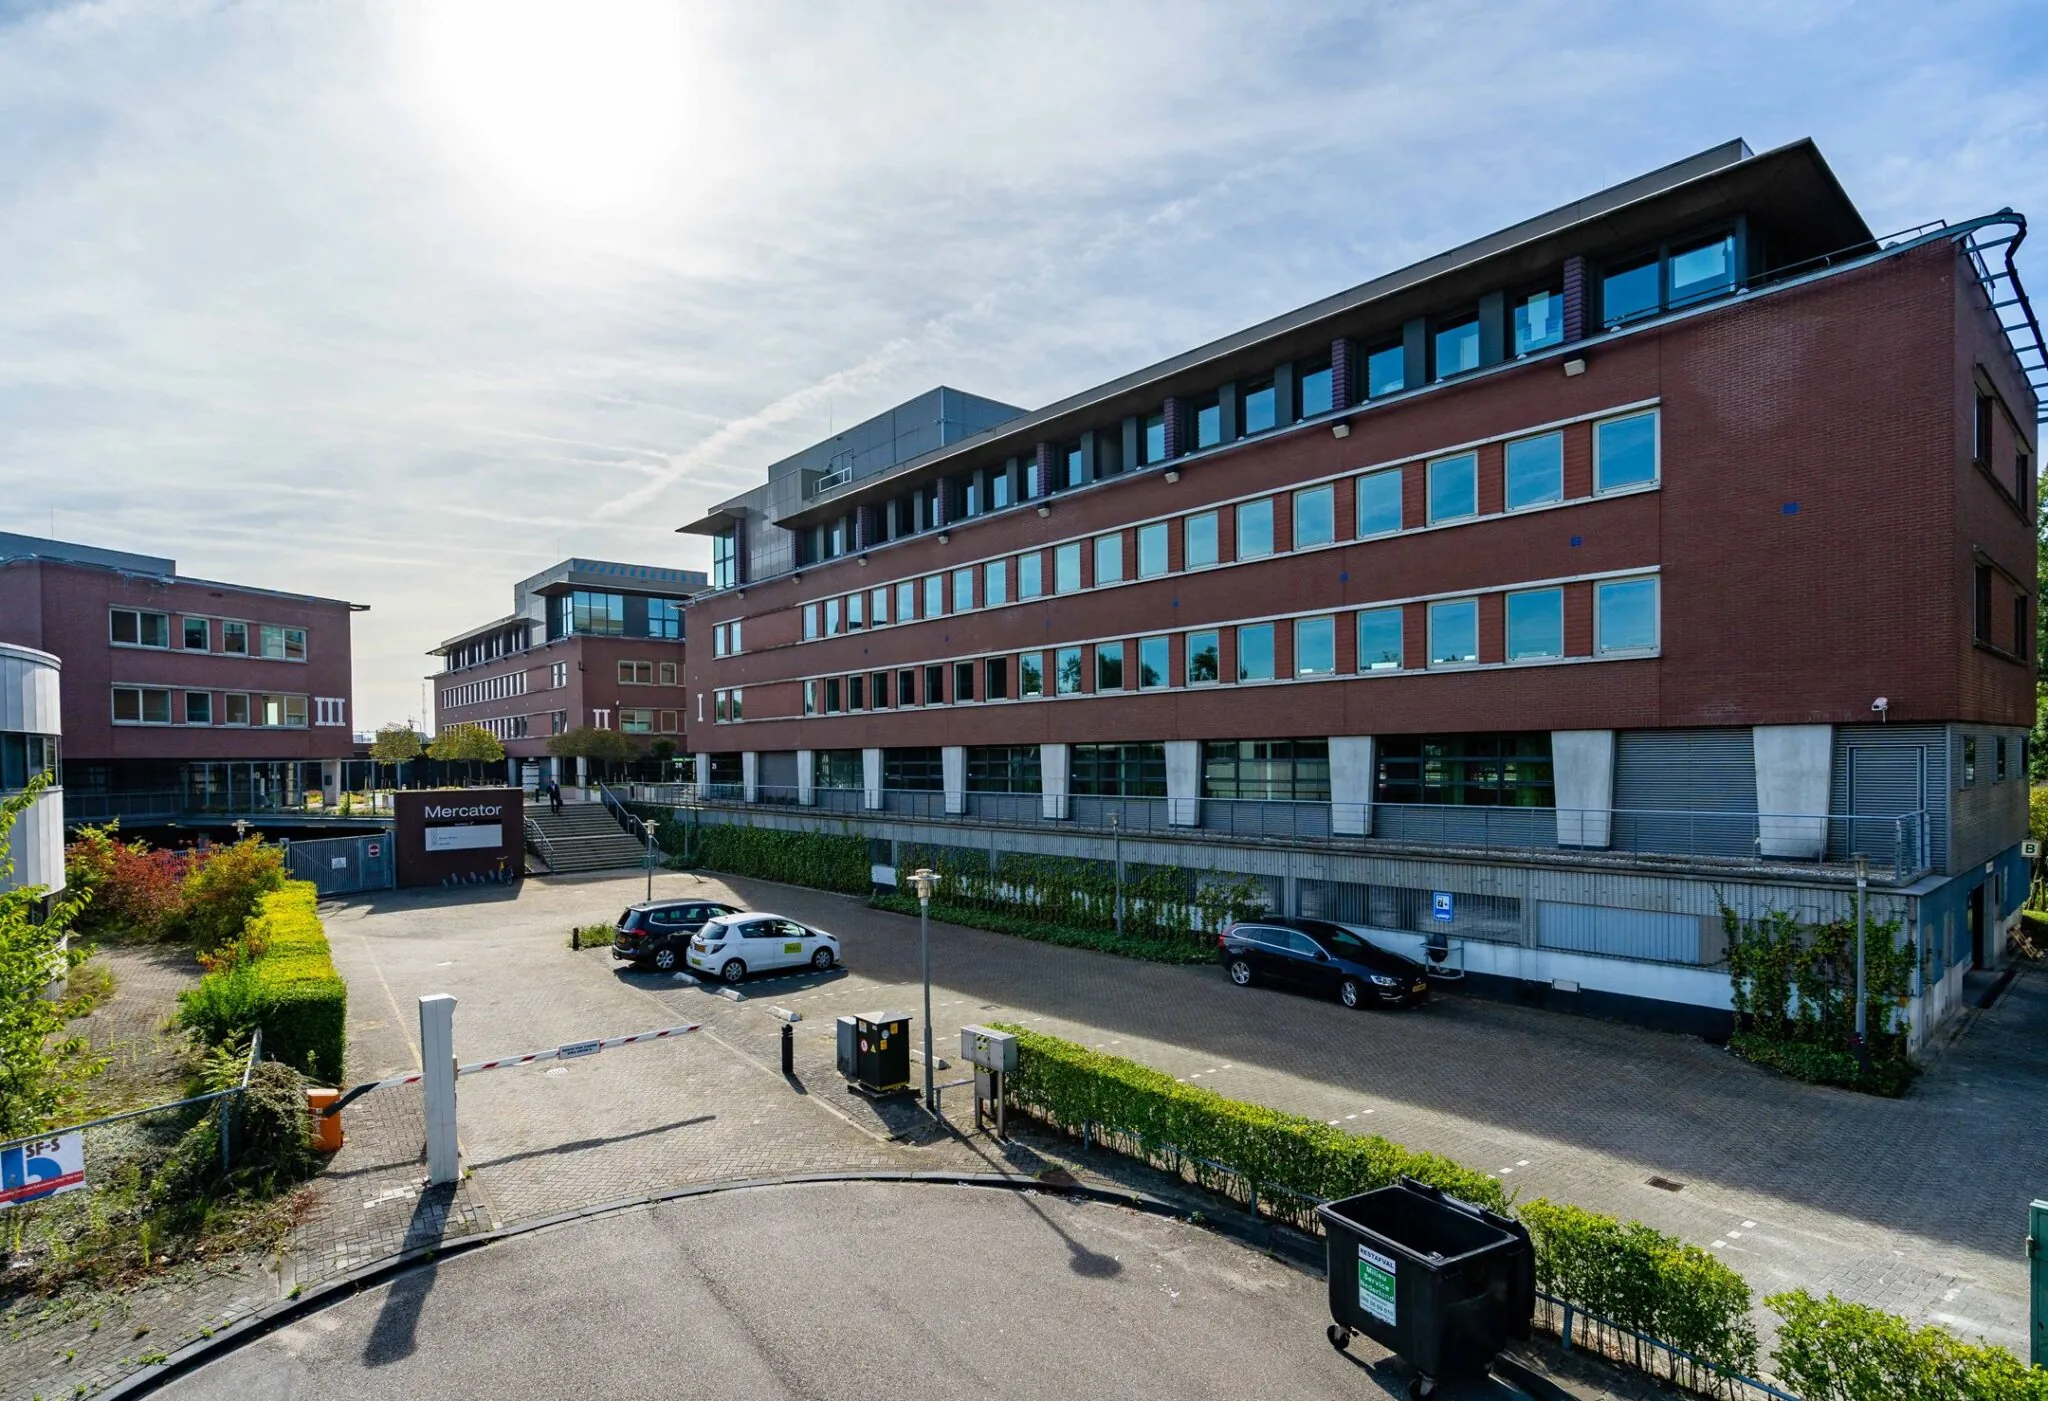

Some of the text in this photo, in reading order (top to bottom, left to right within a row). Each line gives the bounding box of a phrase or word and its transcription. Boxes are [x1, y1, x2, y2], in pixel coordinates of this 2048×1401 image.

[424, 804, 502, 819] Mercator
[2025, 843, 2036, 854] B
[25, 1136, 61, 1159] SF-S
[1359, 1247, 1395, 1269] RESTAFVAL
[1363, 1272, 1390, 1292] Service
[1365, 1265, 1387, 1282] Milieu
[1359, 1279, 1394, 1302] Nederland
